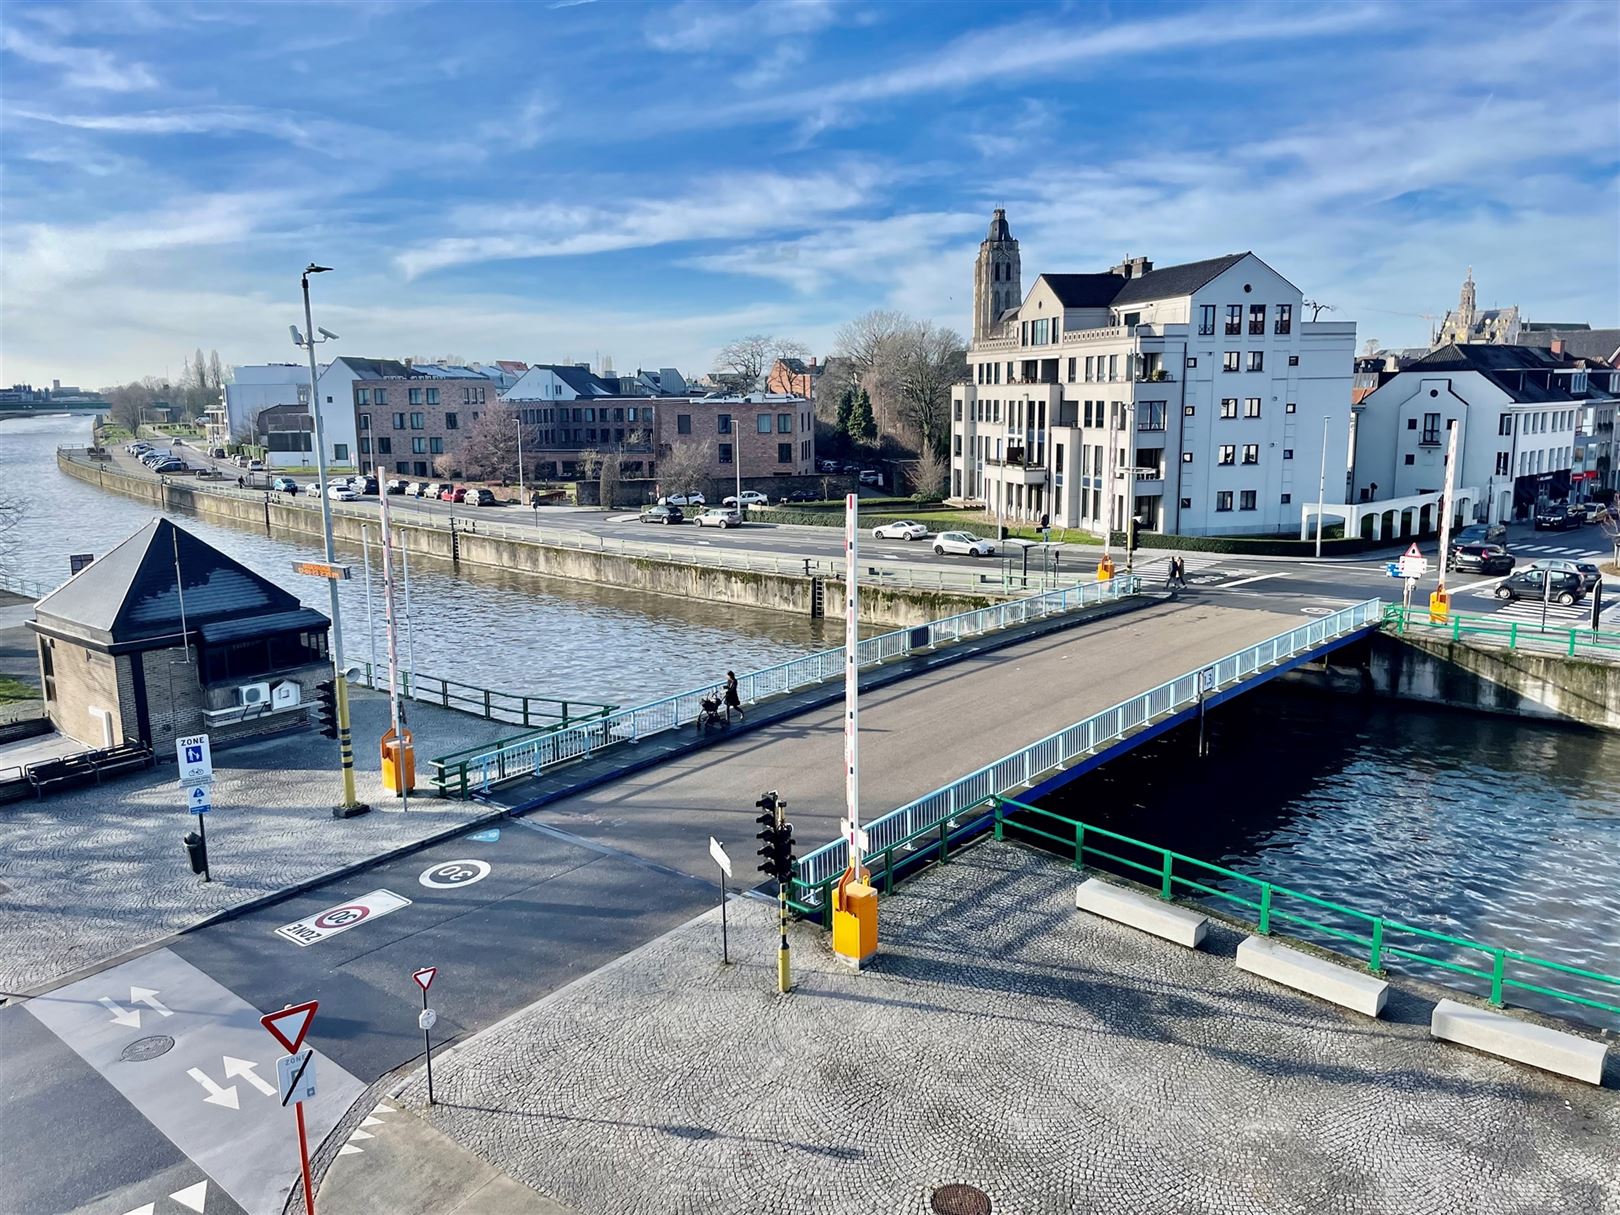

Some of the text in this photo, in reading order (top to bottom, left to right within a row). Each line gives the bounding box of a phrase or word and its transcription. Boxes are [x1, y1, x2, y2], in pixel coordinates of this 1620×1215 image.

[181, 736, 205, 747] ZONE
[438, 866, 473, 881] 30
[328, 911, 356, 923] 30
[287, 923, 323, 942] ZONE
